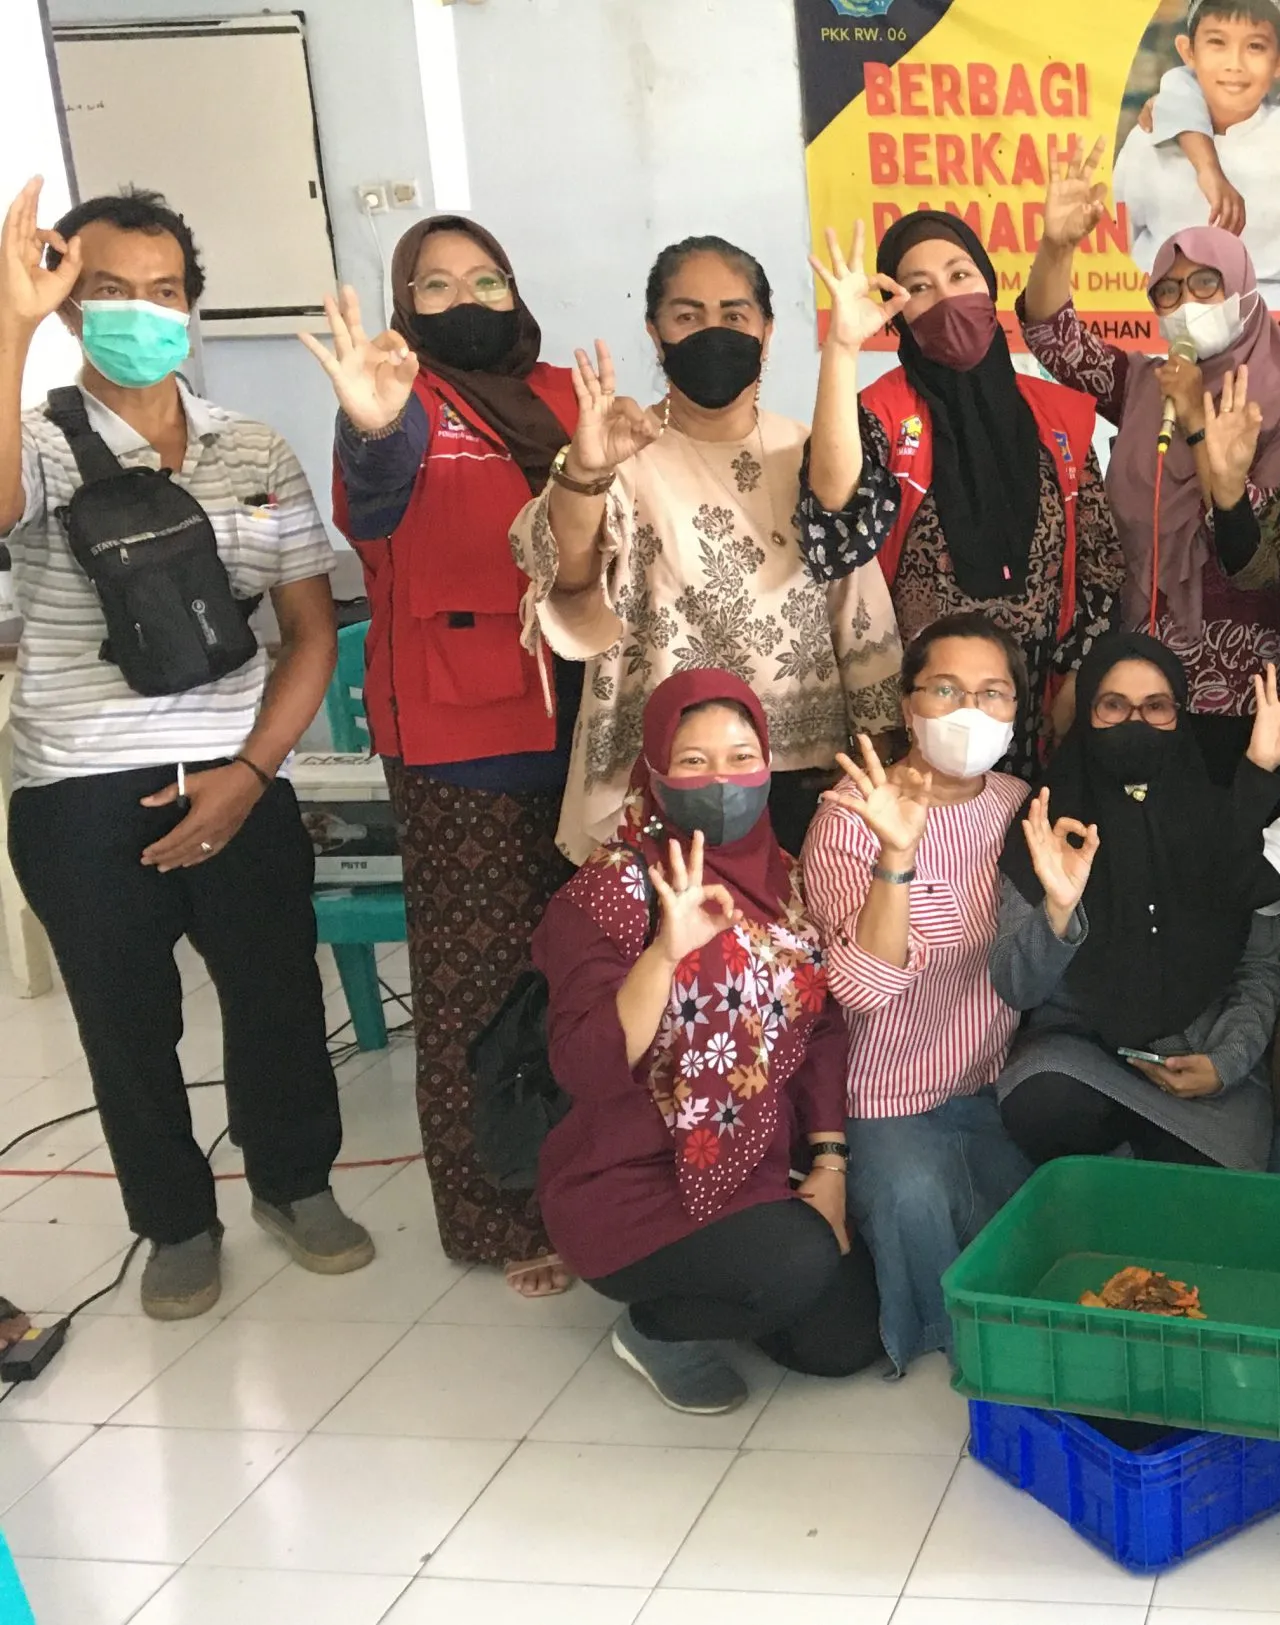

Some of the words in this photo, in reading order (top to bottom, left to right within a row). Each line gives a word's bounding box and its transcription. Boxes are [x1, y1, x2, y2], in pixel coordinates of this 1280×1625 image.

[820, 27, 850, 41] PKK
[854, 27, 883, 41] RW.
[887, 27, 907, 41] 06
[863, 61, 1088, 118] BERBAGI
[868, 132, 1081, 187] BERKAH
[872, 201, 1133, 254] RMADN
